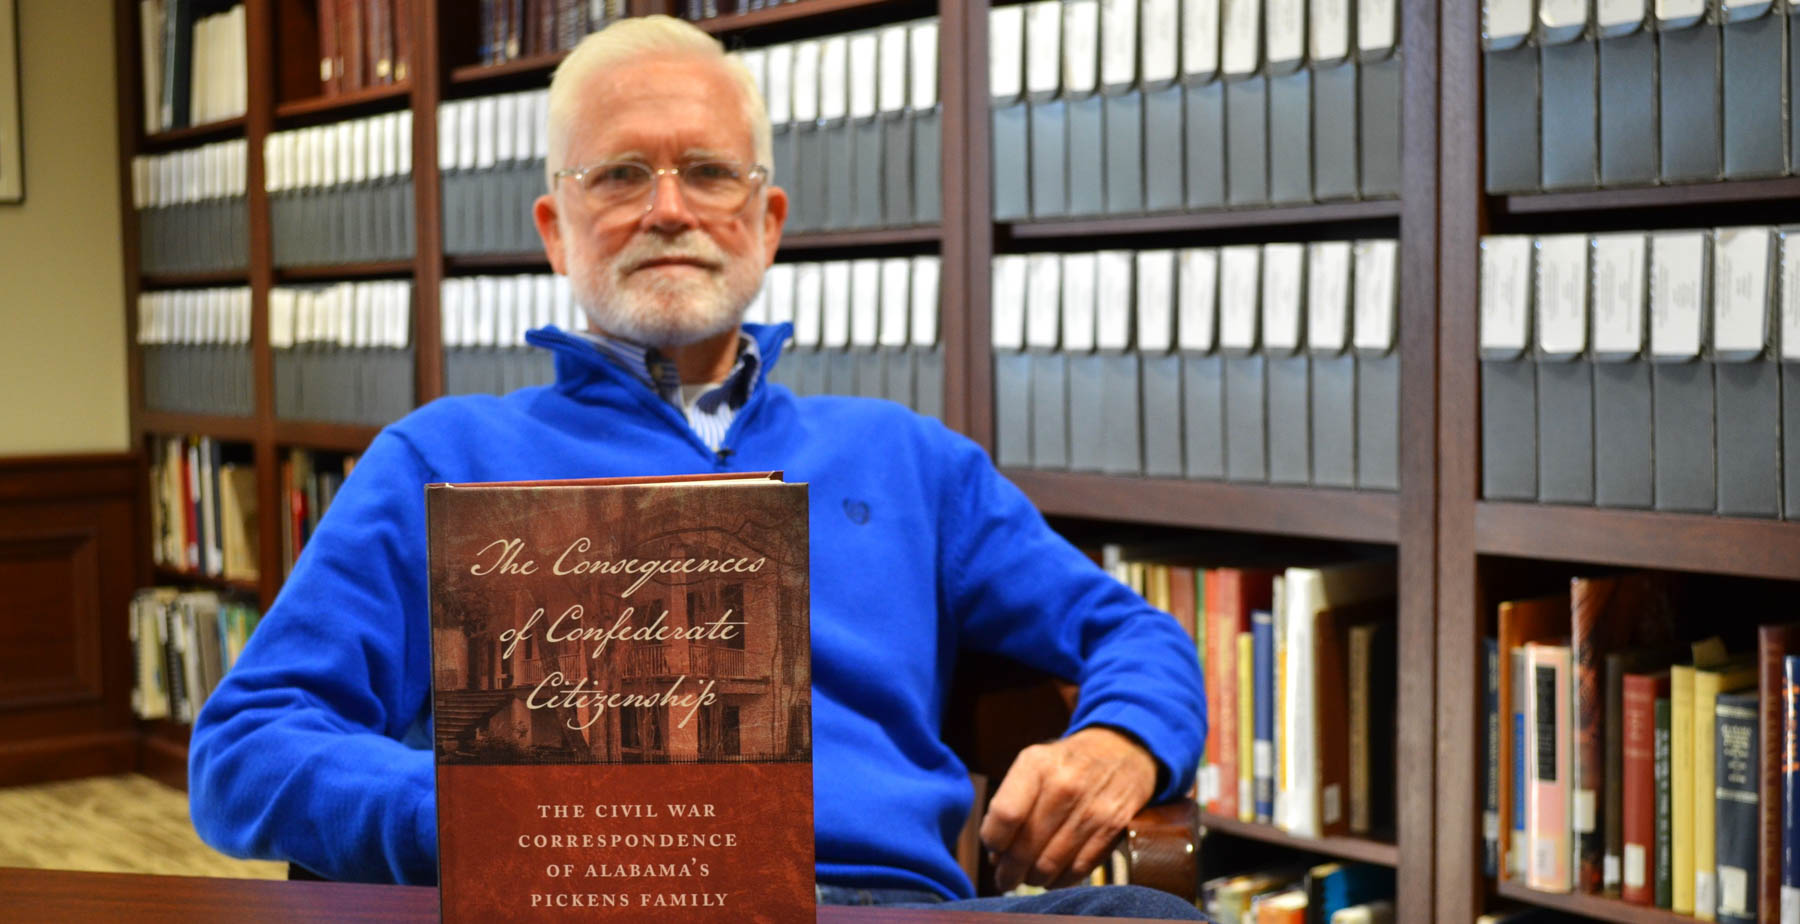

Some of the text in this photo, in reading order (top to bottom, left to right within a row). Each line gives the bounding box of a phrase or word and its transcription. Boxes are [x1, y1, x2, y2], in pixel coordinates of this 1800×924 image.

[471, 537, 765, 598] The Consequences
[499, 604, 749, 659] of Confederate
[526, 671, 718, 730] Citizenship
[538, 804, 716, 819] THE CIVIL WAR
[519, 833, 737, 848] CORRESPONDENCE
[546, 858, 709, 878] OF ALABAMA'S
[531, 892, 729, 907] PICKENS FAMILY
